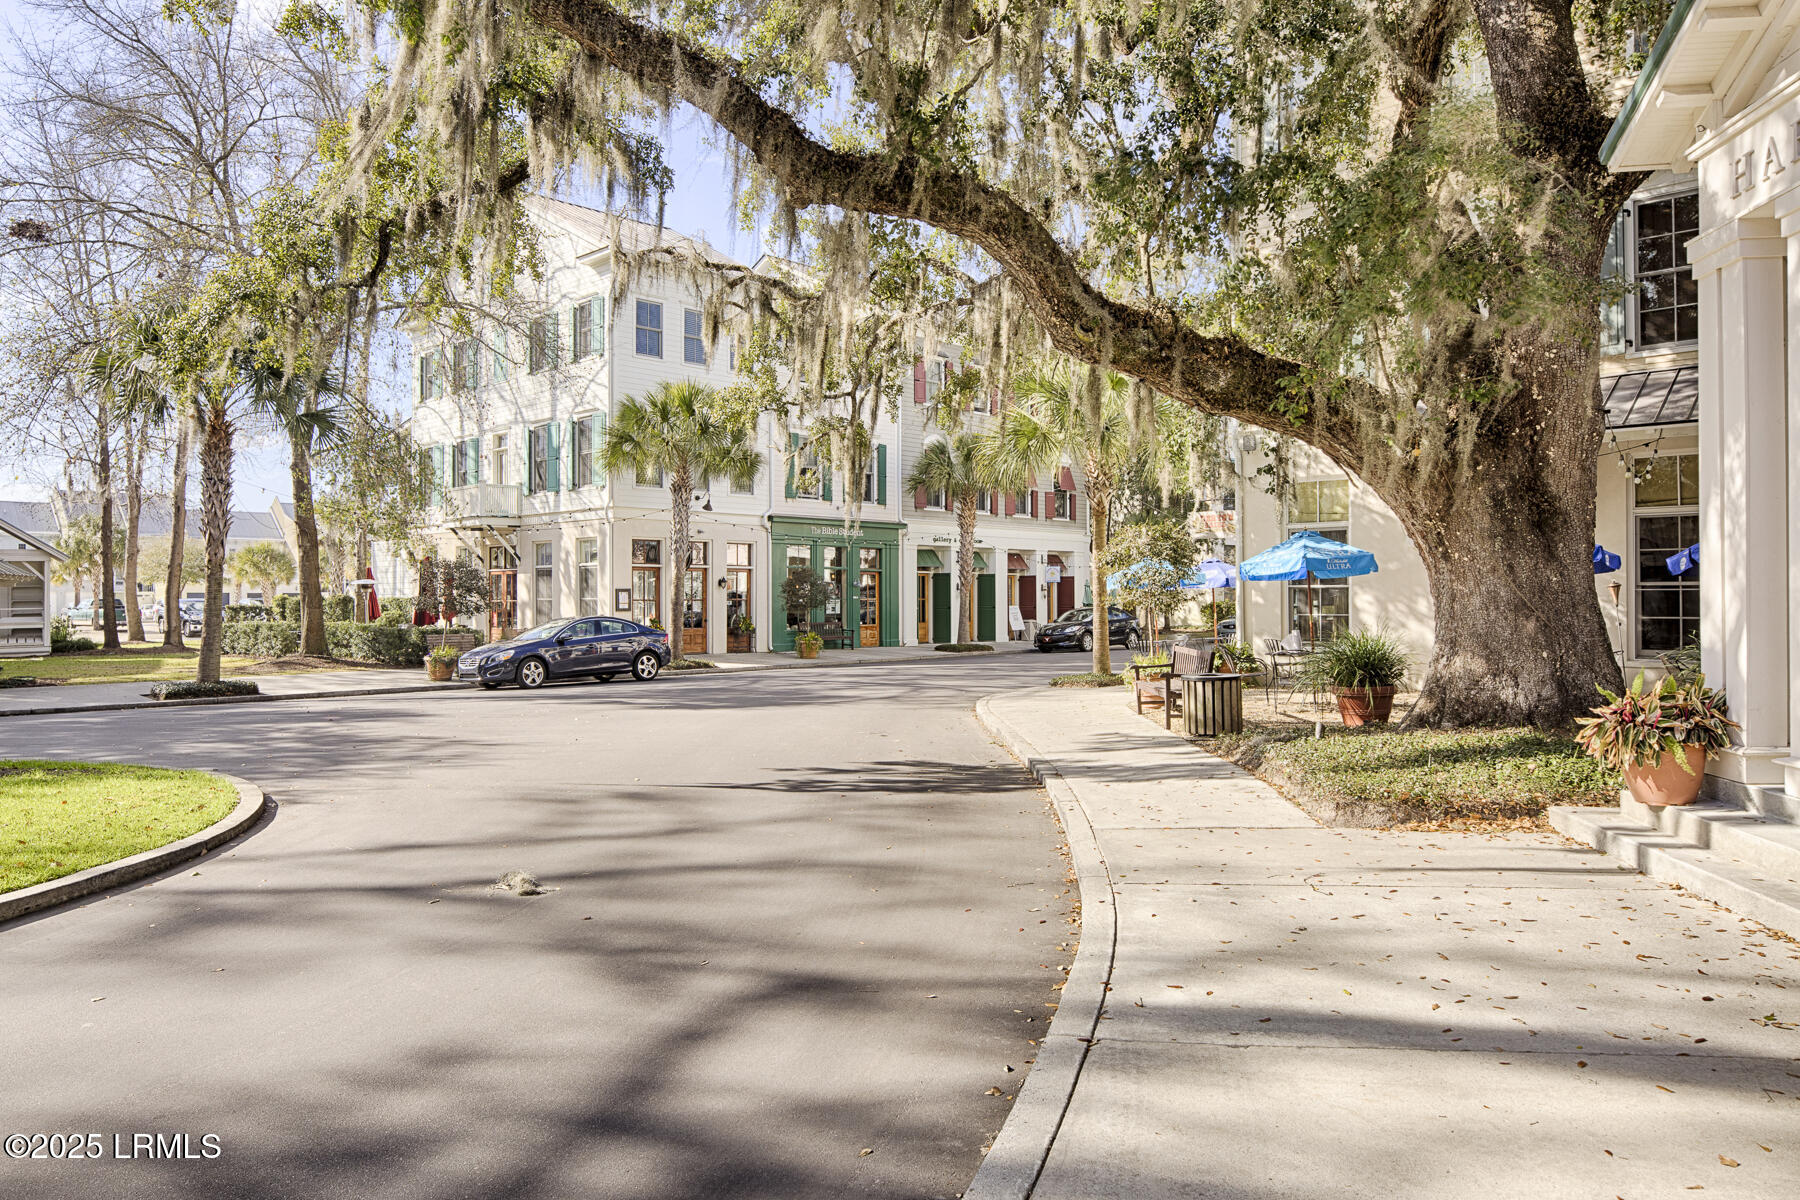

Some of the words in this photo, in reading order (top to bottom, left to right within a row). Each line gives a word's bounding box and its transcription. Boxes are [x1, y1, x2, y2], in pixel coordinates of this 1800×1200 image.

[1729, 119, 1800, 200] HA
[821, 527, 839, 535] Bible
[1326, 562, 1352, 570] ULTRA
